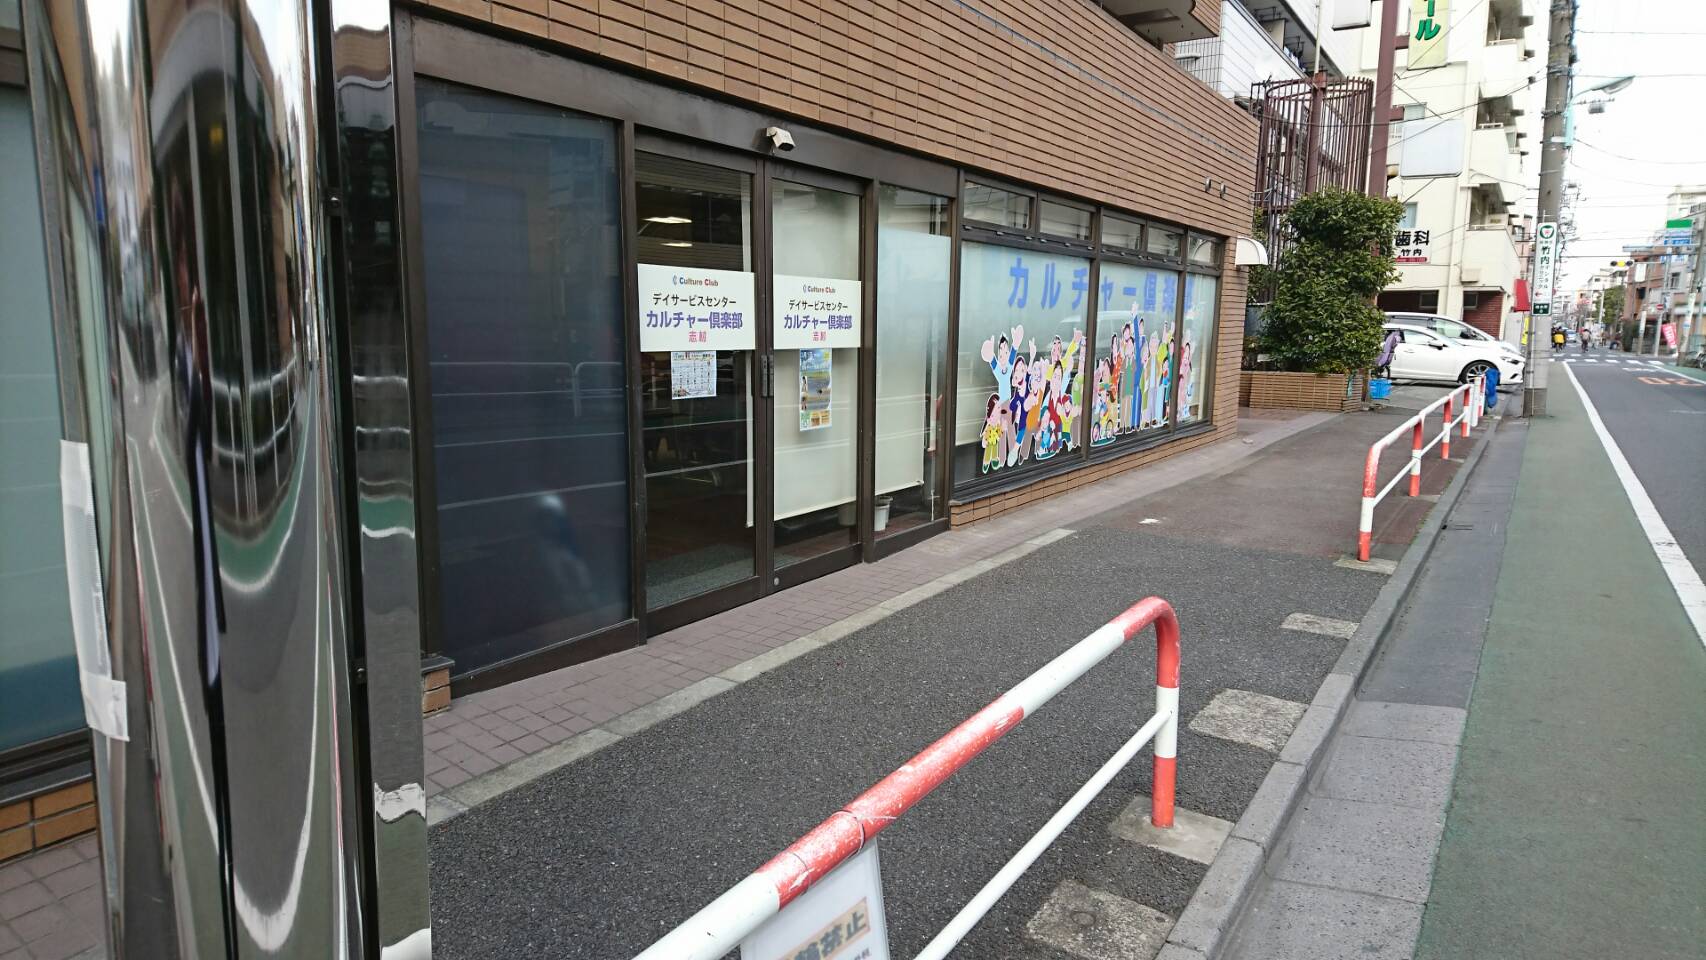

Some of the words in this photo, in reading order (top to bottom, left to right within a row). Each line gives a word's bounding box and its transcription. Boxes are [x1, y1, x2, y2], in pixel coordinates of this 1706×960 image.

[1395, 230, 1430, 246] 歯科
[1401, 248, 1422, 257] 竹内
[1541, 245, 1551, 264] 竹内
[679, 276, 703, 286] Culture
[704, 278, 719, 287] Club
[807, 285, 824, 293] Culture
[653, 292, 737, 308] デイサービスセンター
[788, 299, 848, 311] デイサービスセンター
[646, 310, 743, 329] カルチャー倶楽部
[784, 314, 853, 330] カルチャー倶楽部
